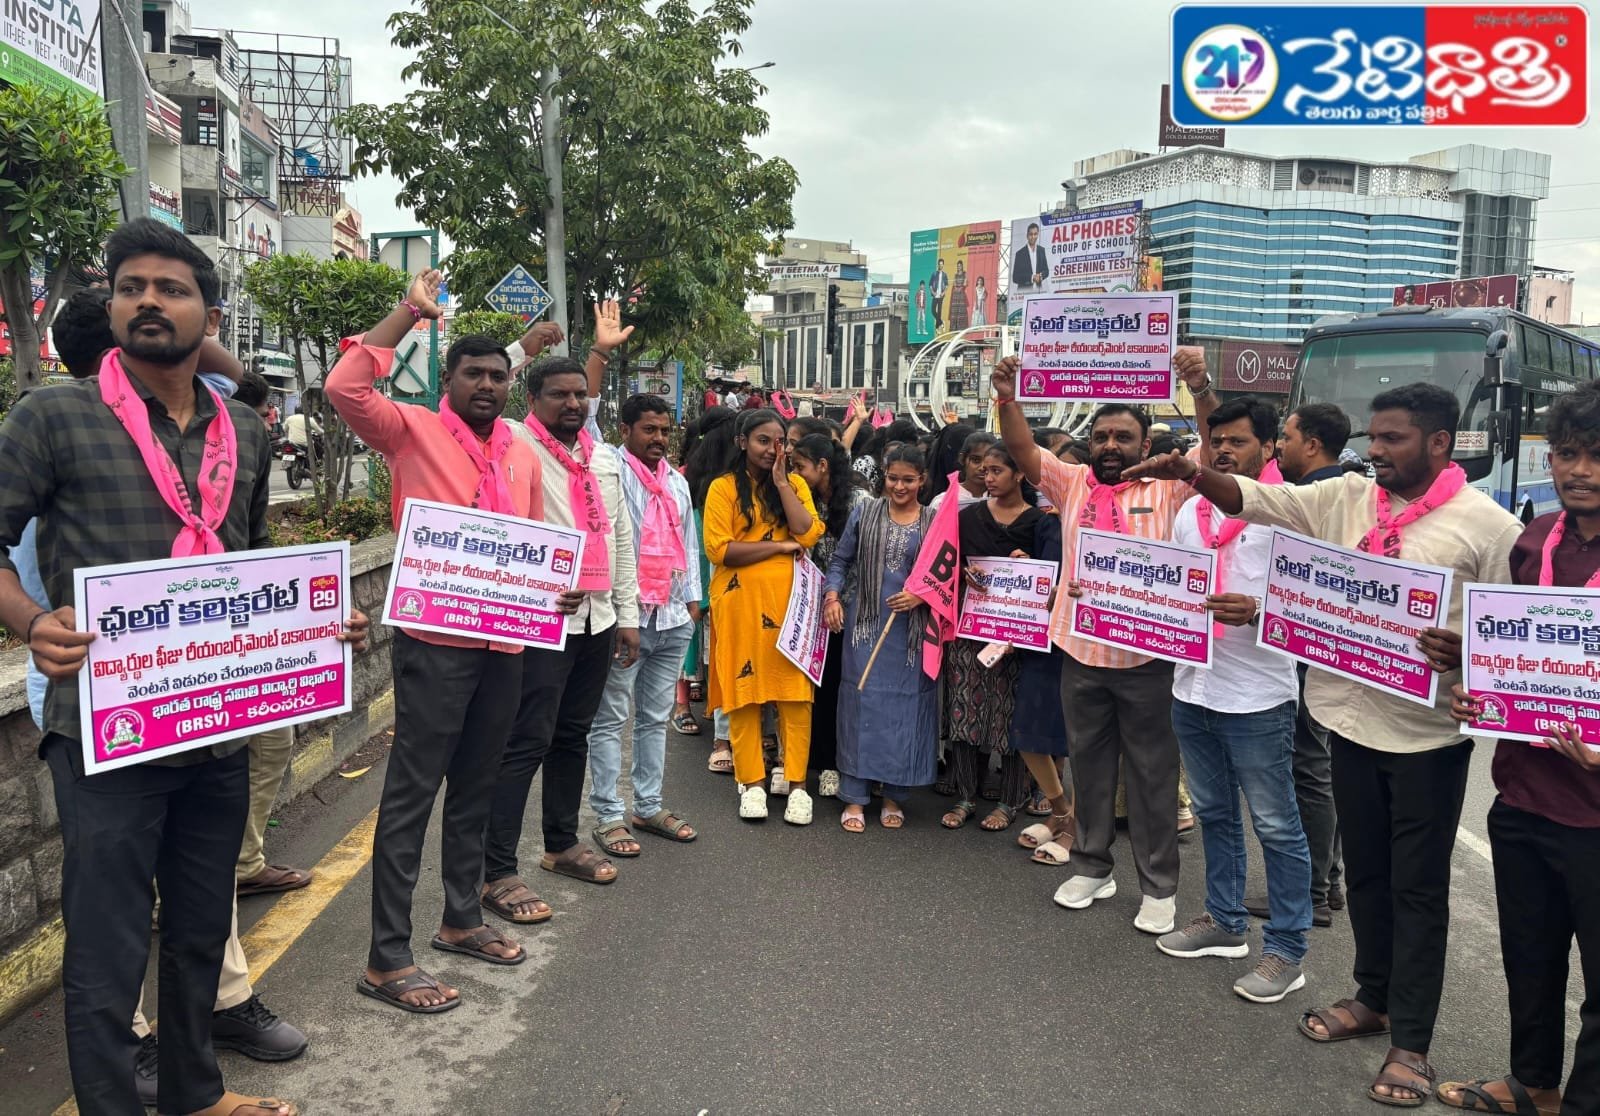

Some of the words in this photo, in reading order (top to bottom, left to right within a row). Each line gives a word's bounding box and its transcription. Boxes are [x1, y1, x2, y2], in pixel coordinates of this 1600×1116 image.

[3, 20, 26, 47] IIT-JEE
[34, 39, 51, 61] NEET
[4, 0, 97, 70] INSTITUTE
[1165, 124, 1219, 134] MALABAR
[1051, 216, 1136, 243] ALPHORES
[1051, 242, 1079, 254] GROUP
[1081, 240, 1093, 251] OF
[1095, 236, 1134, 249] SCHOOLS
[786, 265, 819, 274] GEETHA
[822, 265, 839, 273] A/C
[1053, 260, 1105, 276] SCREENING
[1108, 257, 1132, 271] TEST
[501, 304, 539, 313] TOILETS
[553, 558, 570, 572] 29
[313, 589, 335, 607] 29
[1410, 599, 1431, 617] 29
[443, 612, 481, 628] (BRSV)
[1304, 644, 1339, 664] (BRSV)
[127, 678, 169, 698] వెంటనే
[172, 671, 217, 689] విడుదల
[220, 661, 272, 680] చేయాలని
[274, 650, 316, 670] డిమాండ్
[152, 698, 190, 717] భారత
[224, 684, 257, 702] సమితి
[299, 669, 336, 687] విభాగం
[175, 710, 229, 737] (BRSV)
[247, 691, 315, 718] కరీంనగర్
